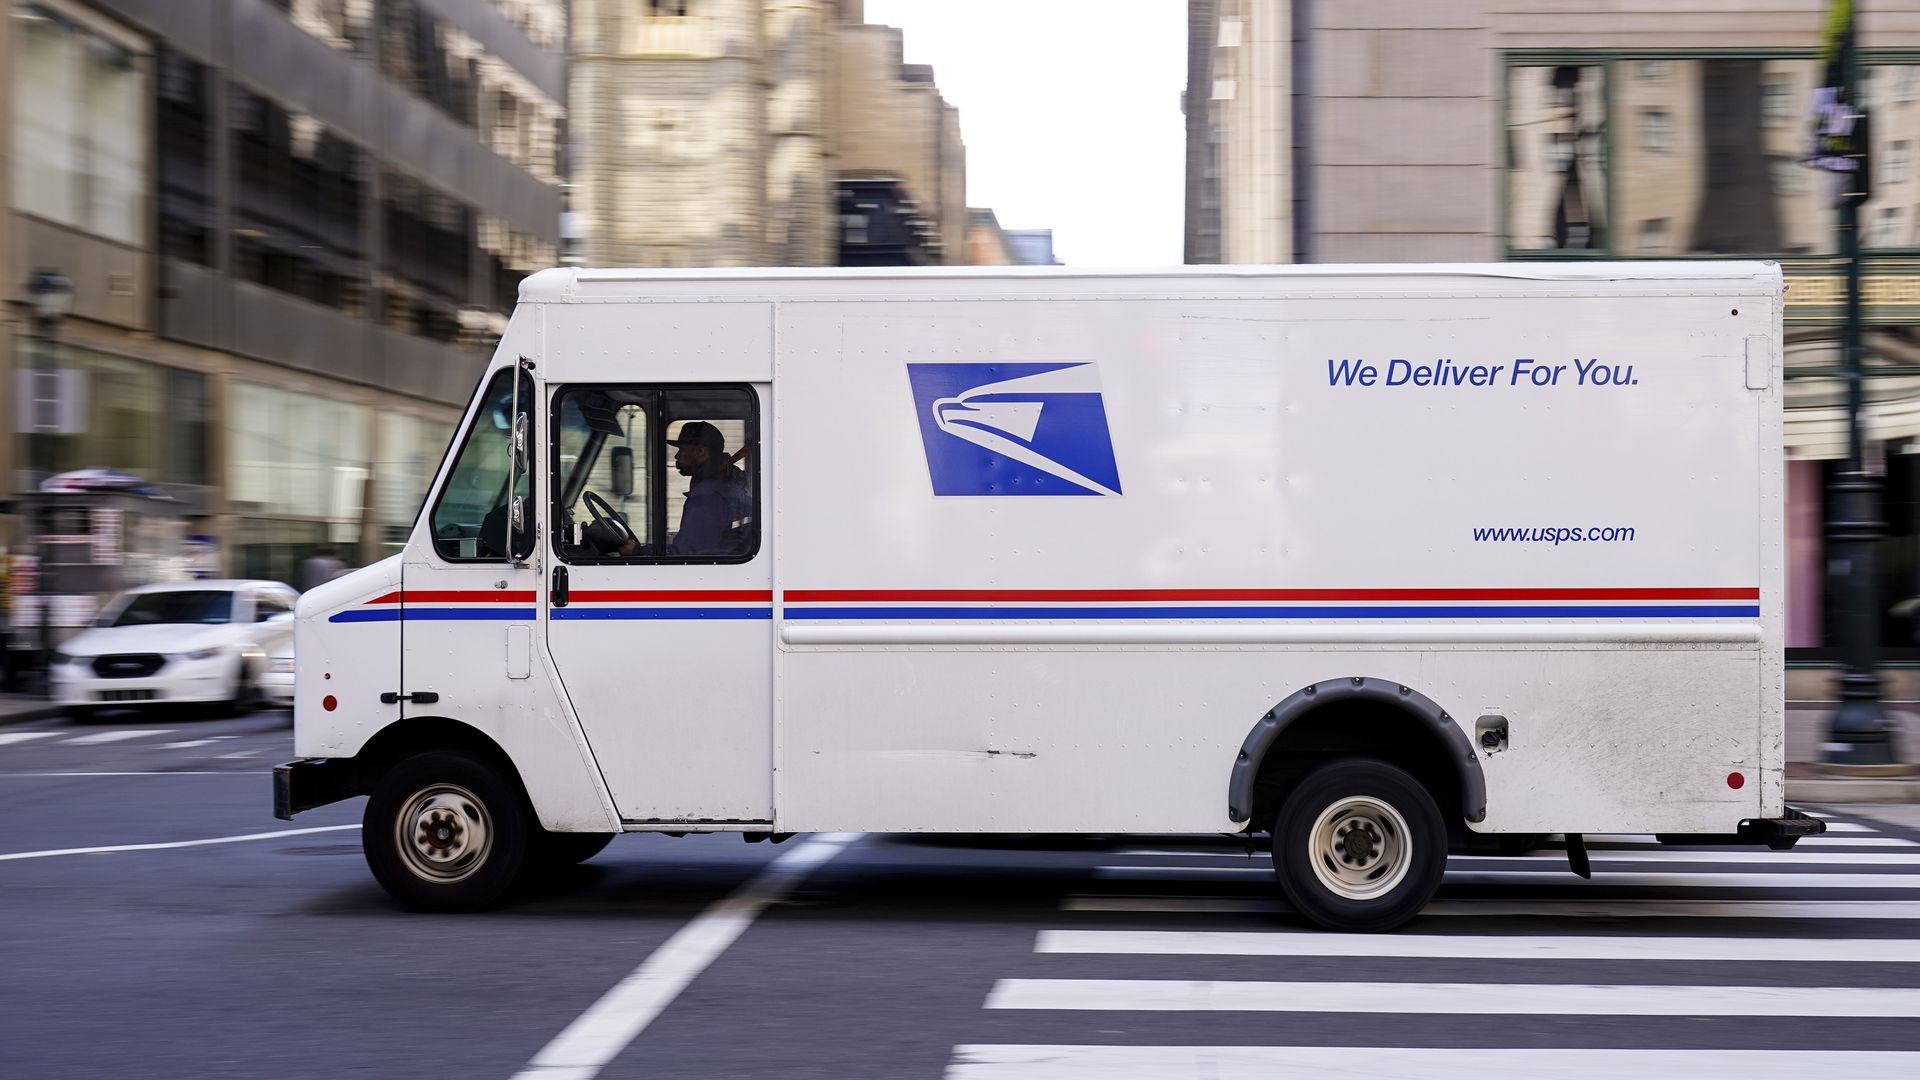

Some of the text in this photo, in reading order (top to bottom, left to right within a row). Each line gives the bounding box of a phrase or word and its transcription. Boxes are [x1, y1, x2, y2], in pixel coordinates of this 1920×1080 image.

[1327, 358, 1638, 386] We Deliver For You.
[1473, 526, 1635, 546] www.usps.com
